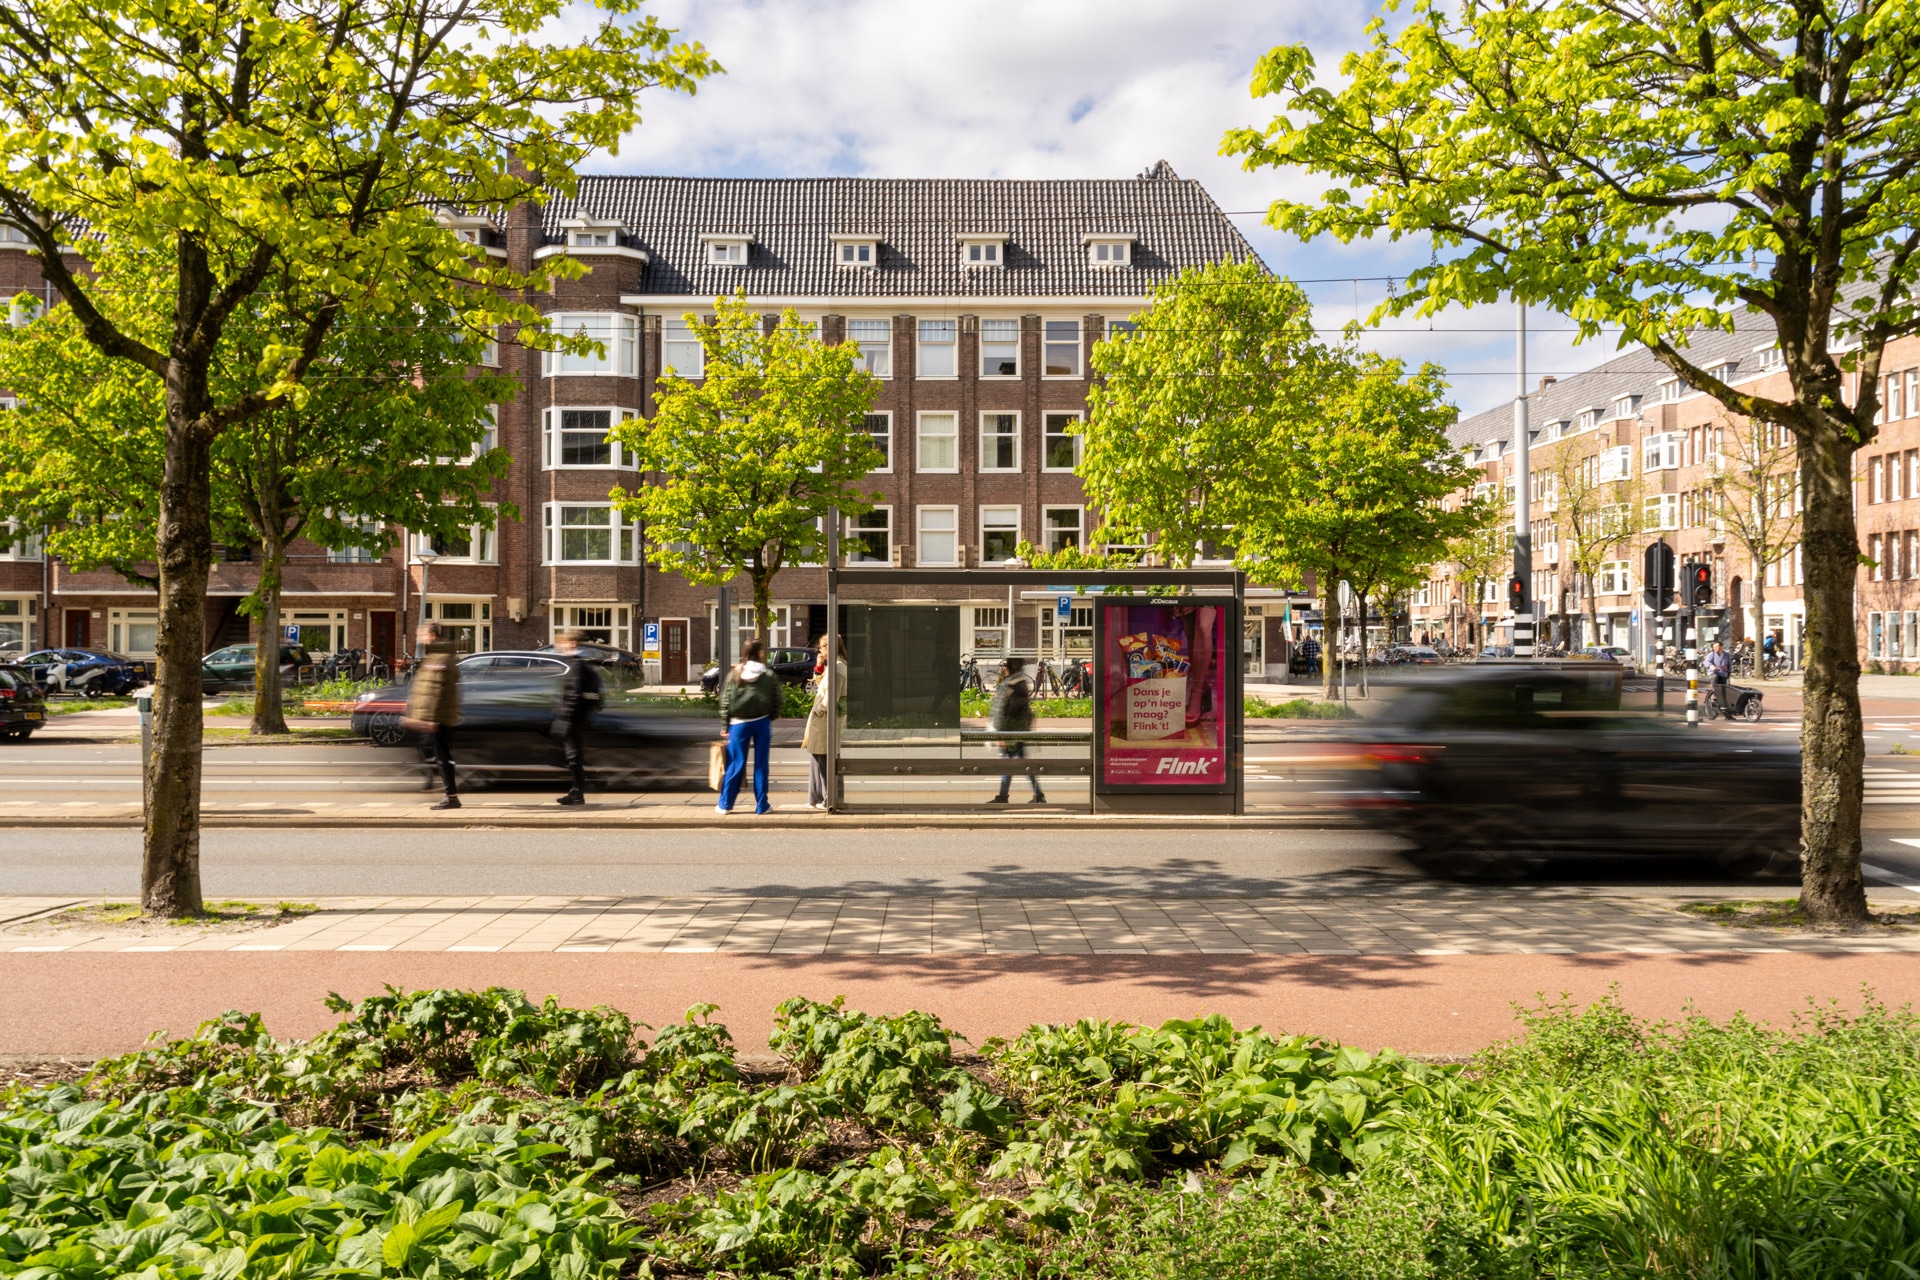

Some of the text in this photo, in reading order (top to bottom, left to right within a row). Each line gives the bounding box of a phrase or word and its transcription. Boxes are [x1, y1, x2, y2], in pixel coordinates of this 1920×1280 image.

[1060, 597, 1068, 607] P
[288, 626, 296, 637] P
[647, 625, 655, 636] P
[1133, 687, 1171, 698] Dans je
[1133, 699, 1182, 710] op 'n lege
[1133, 710, 1169, 721] maag?
[1133, 722, 1169, 730] Flink 't!
[1156, 757, 1218, 775] Flink
